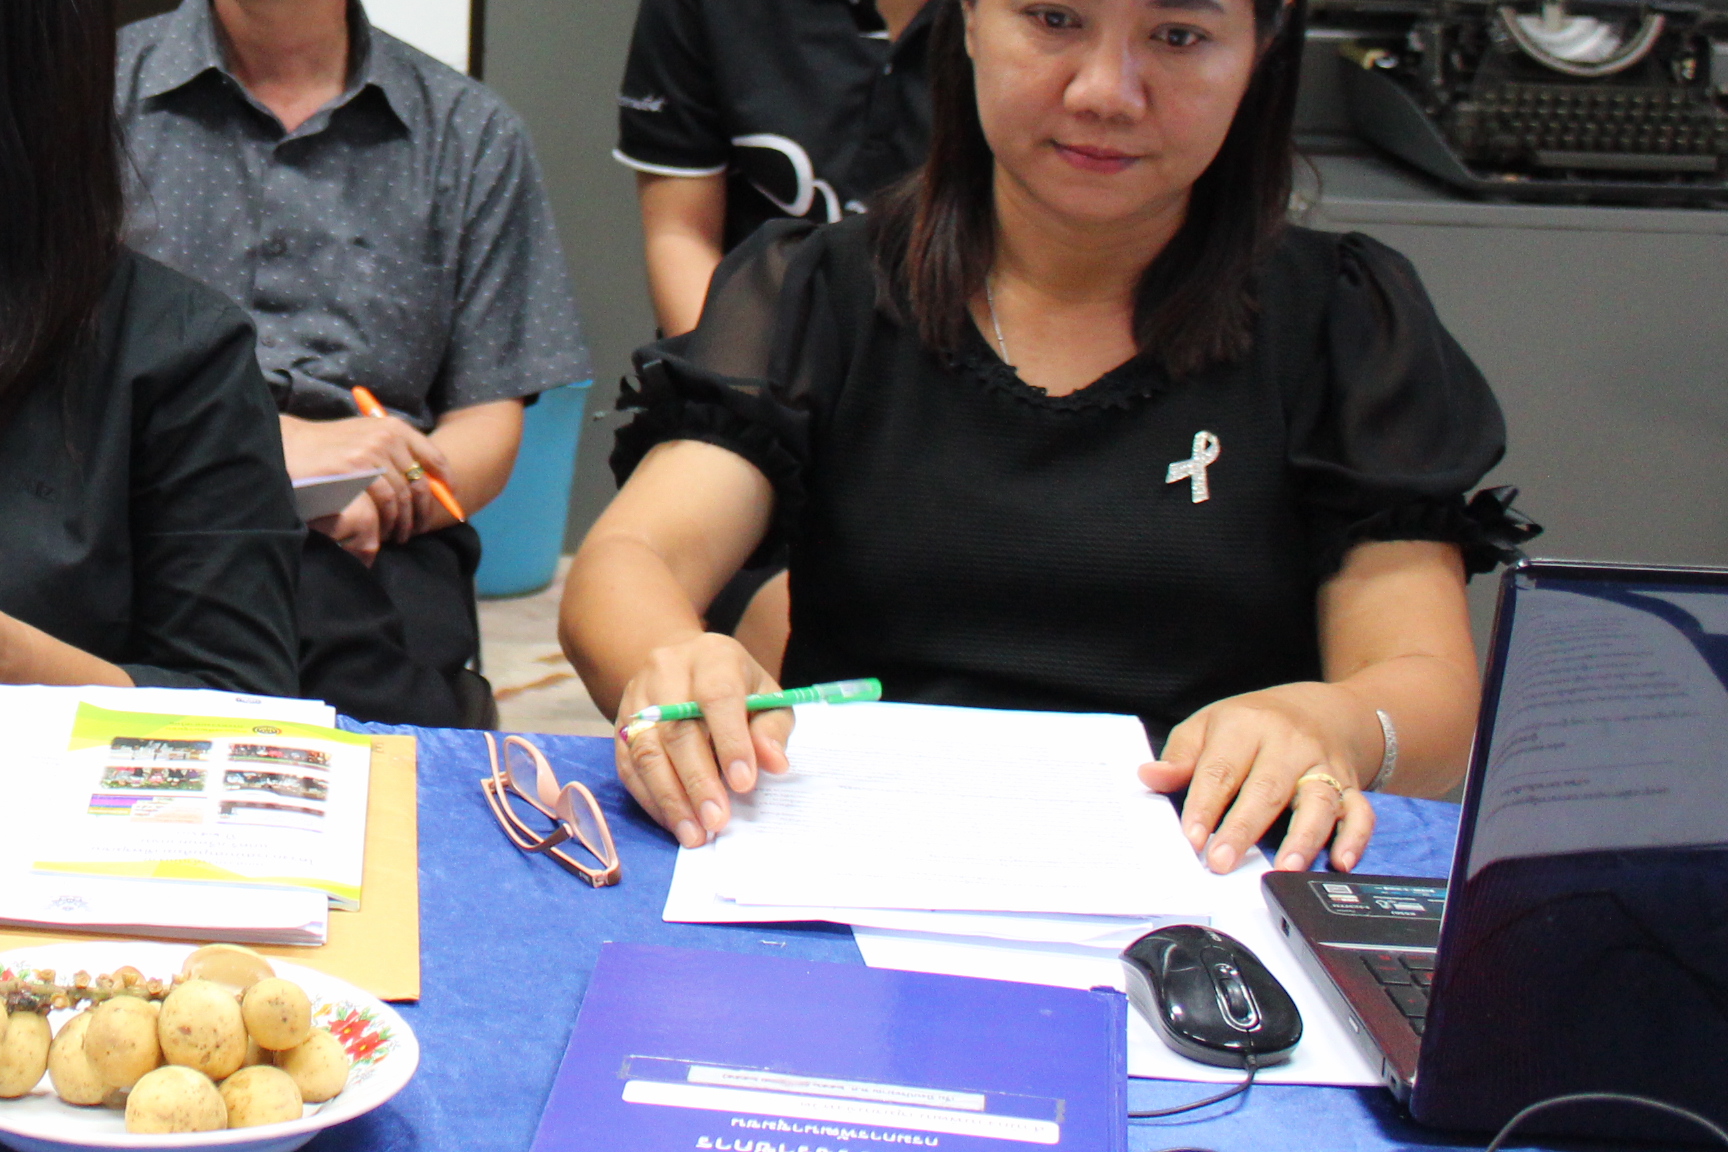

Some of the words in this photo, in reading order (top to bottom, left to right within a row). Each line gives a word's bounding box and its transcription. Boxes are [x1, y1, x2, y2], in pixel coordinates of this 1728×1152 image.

[730, 1117, 939, 1147] กรมการพัฒนาชุมชน
